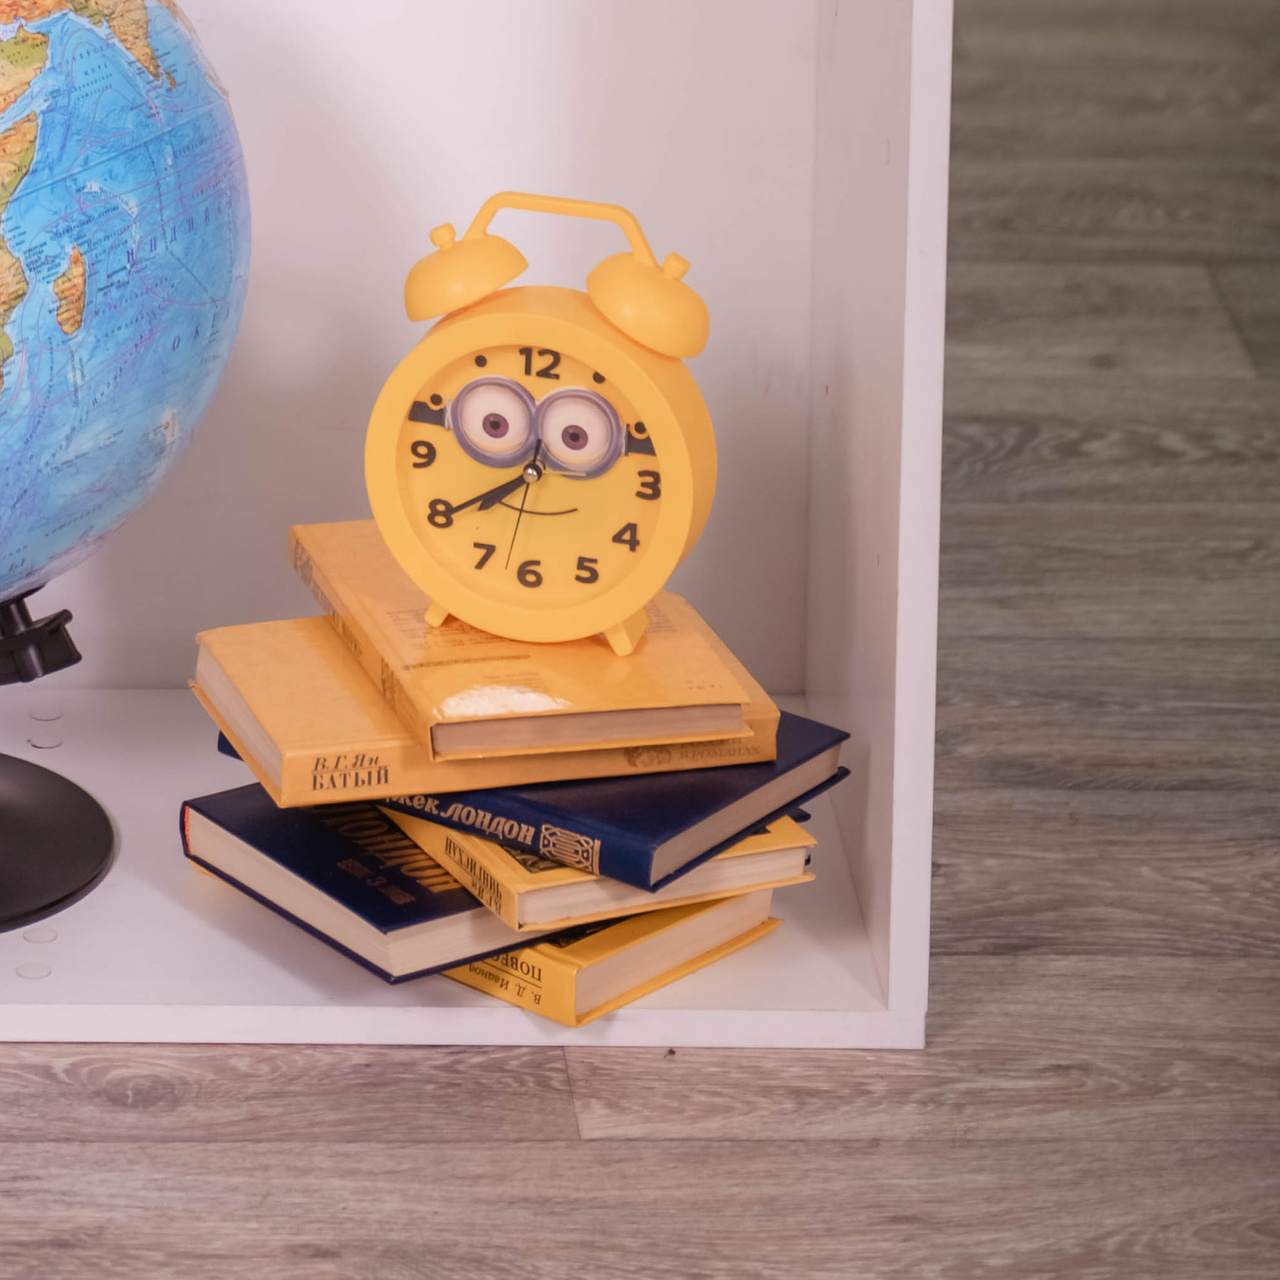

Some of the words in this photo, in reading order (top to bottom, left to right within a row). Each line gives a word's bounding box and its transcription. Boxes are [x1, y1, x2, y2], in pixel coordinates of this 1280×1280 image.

[519, 347, 562, 380] 12
[410, 440, 437, 468] 9
[635, 470, 662, 501] 3
[427, 498, 454, 529] 8
[611, 522, 641, 552] 4
[473, 542, 496, 570] 7
[575, 556, 599, 584] 5
[516, 560, 543, 588] 6
[312, 765, 389, 791] БАТЫЙ
[385, 794, 441, 816] жек
[440, 802, 536, 846] ЛОНДОН
